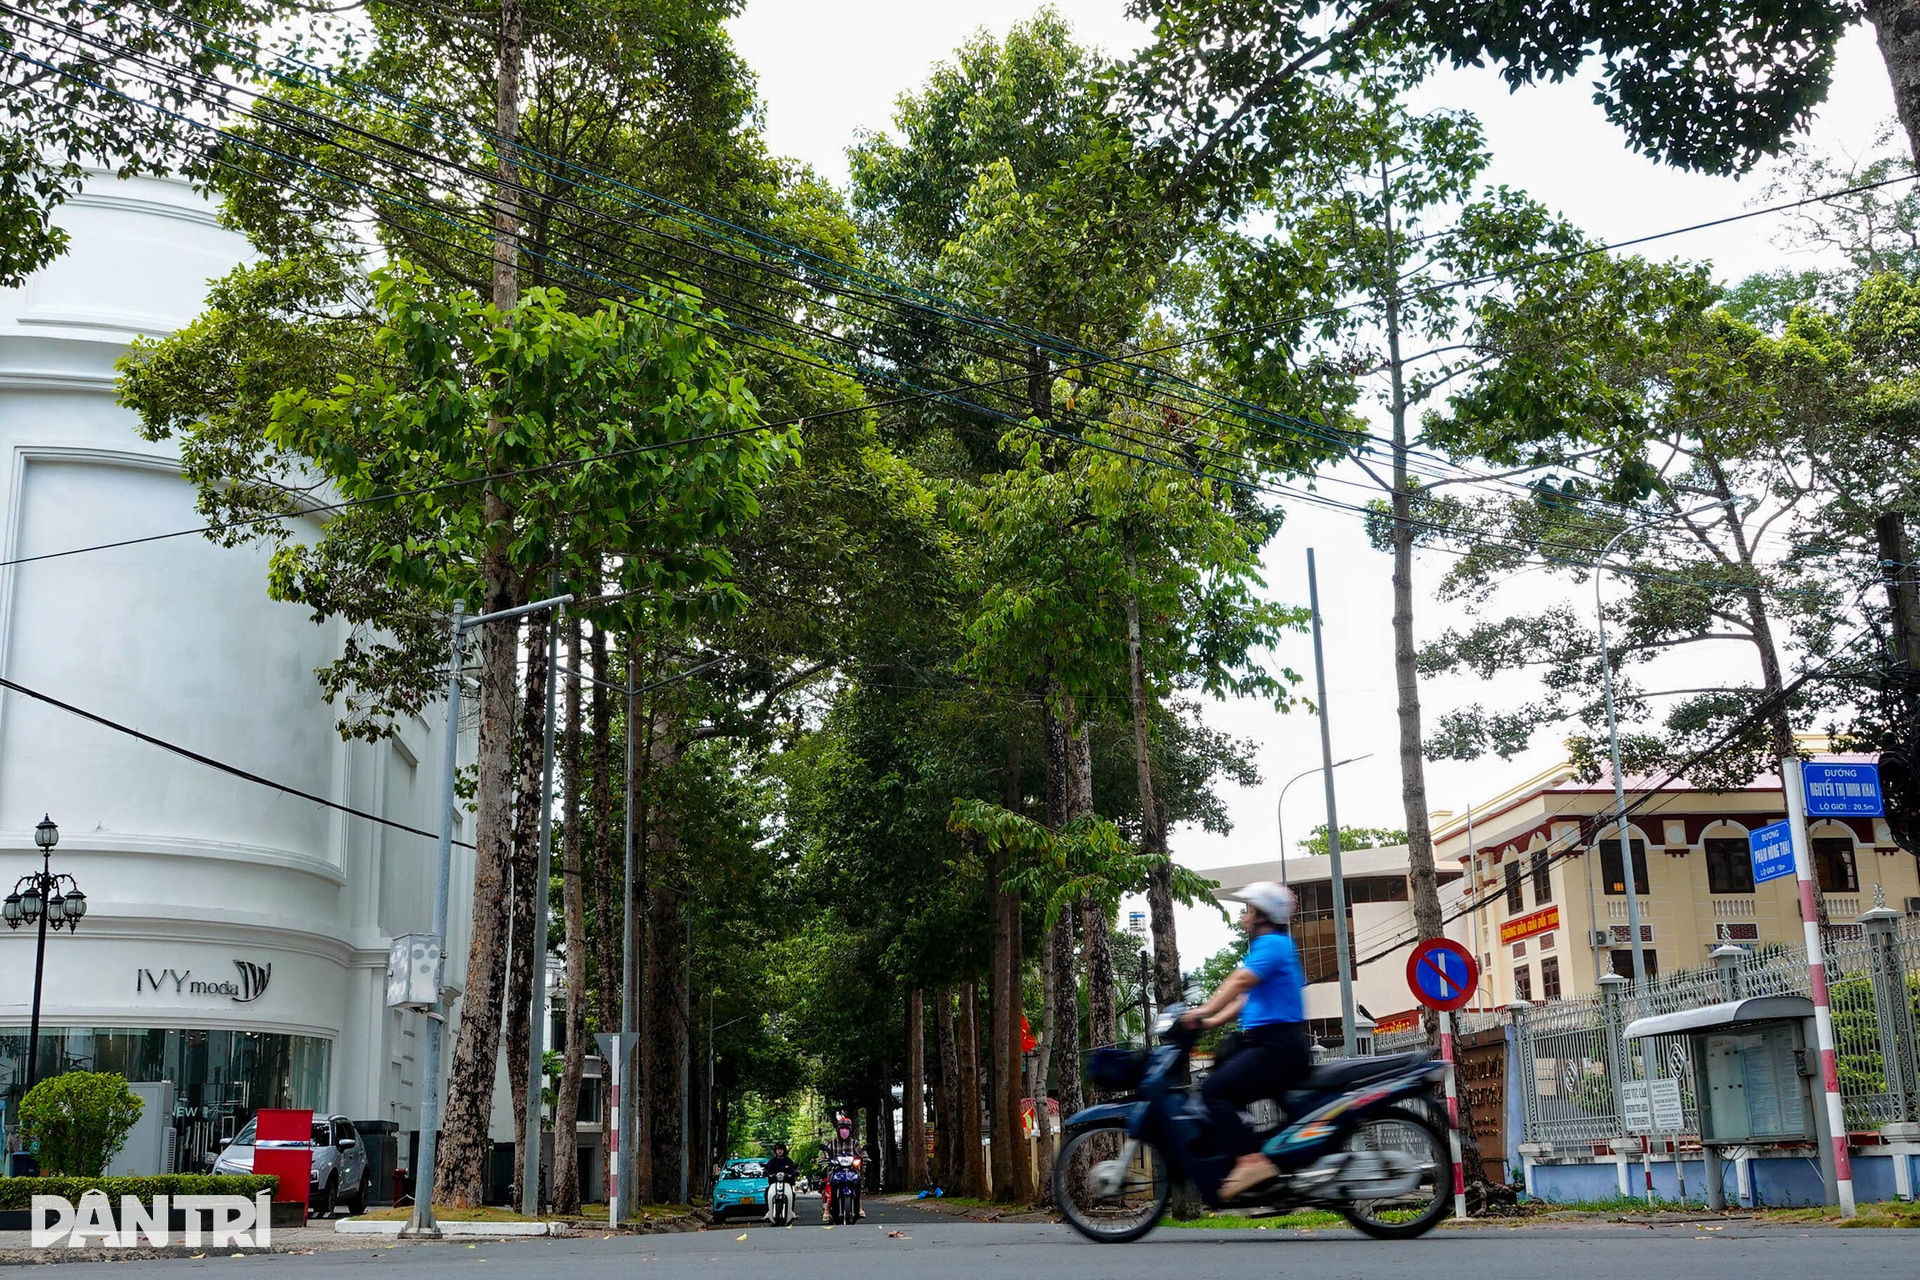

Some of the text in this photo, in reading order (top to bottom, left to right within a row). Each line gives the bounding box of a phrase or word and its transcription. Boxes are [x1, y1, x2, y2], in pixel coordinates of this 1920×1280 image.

[1809, 778, 1876, 800] NGUYỄN THỊ MINH KHAI
[1819, 802, 1830, 811] LỘ
[1754, 837, 1791, 866] PHẠM HỒNG THÁI
[137, 969, 239, 996] IVY moda
